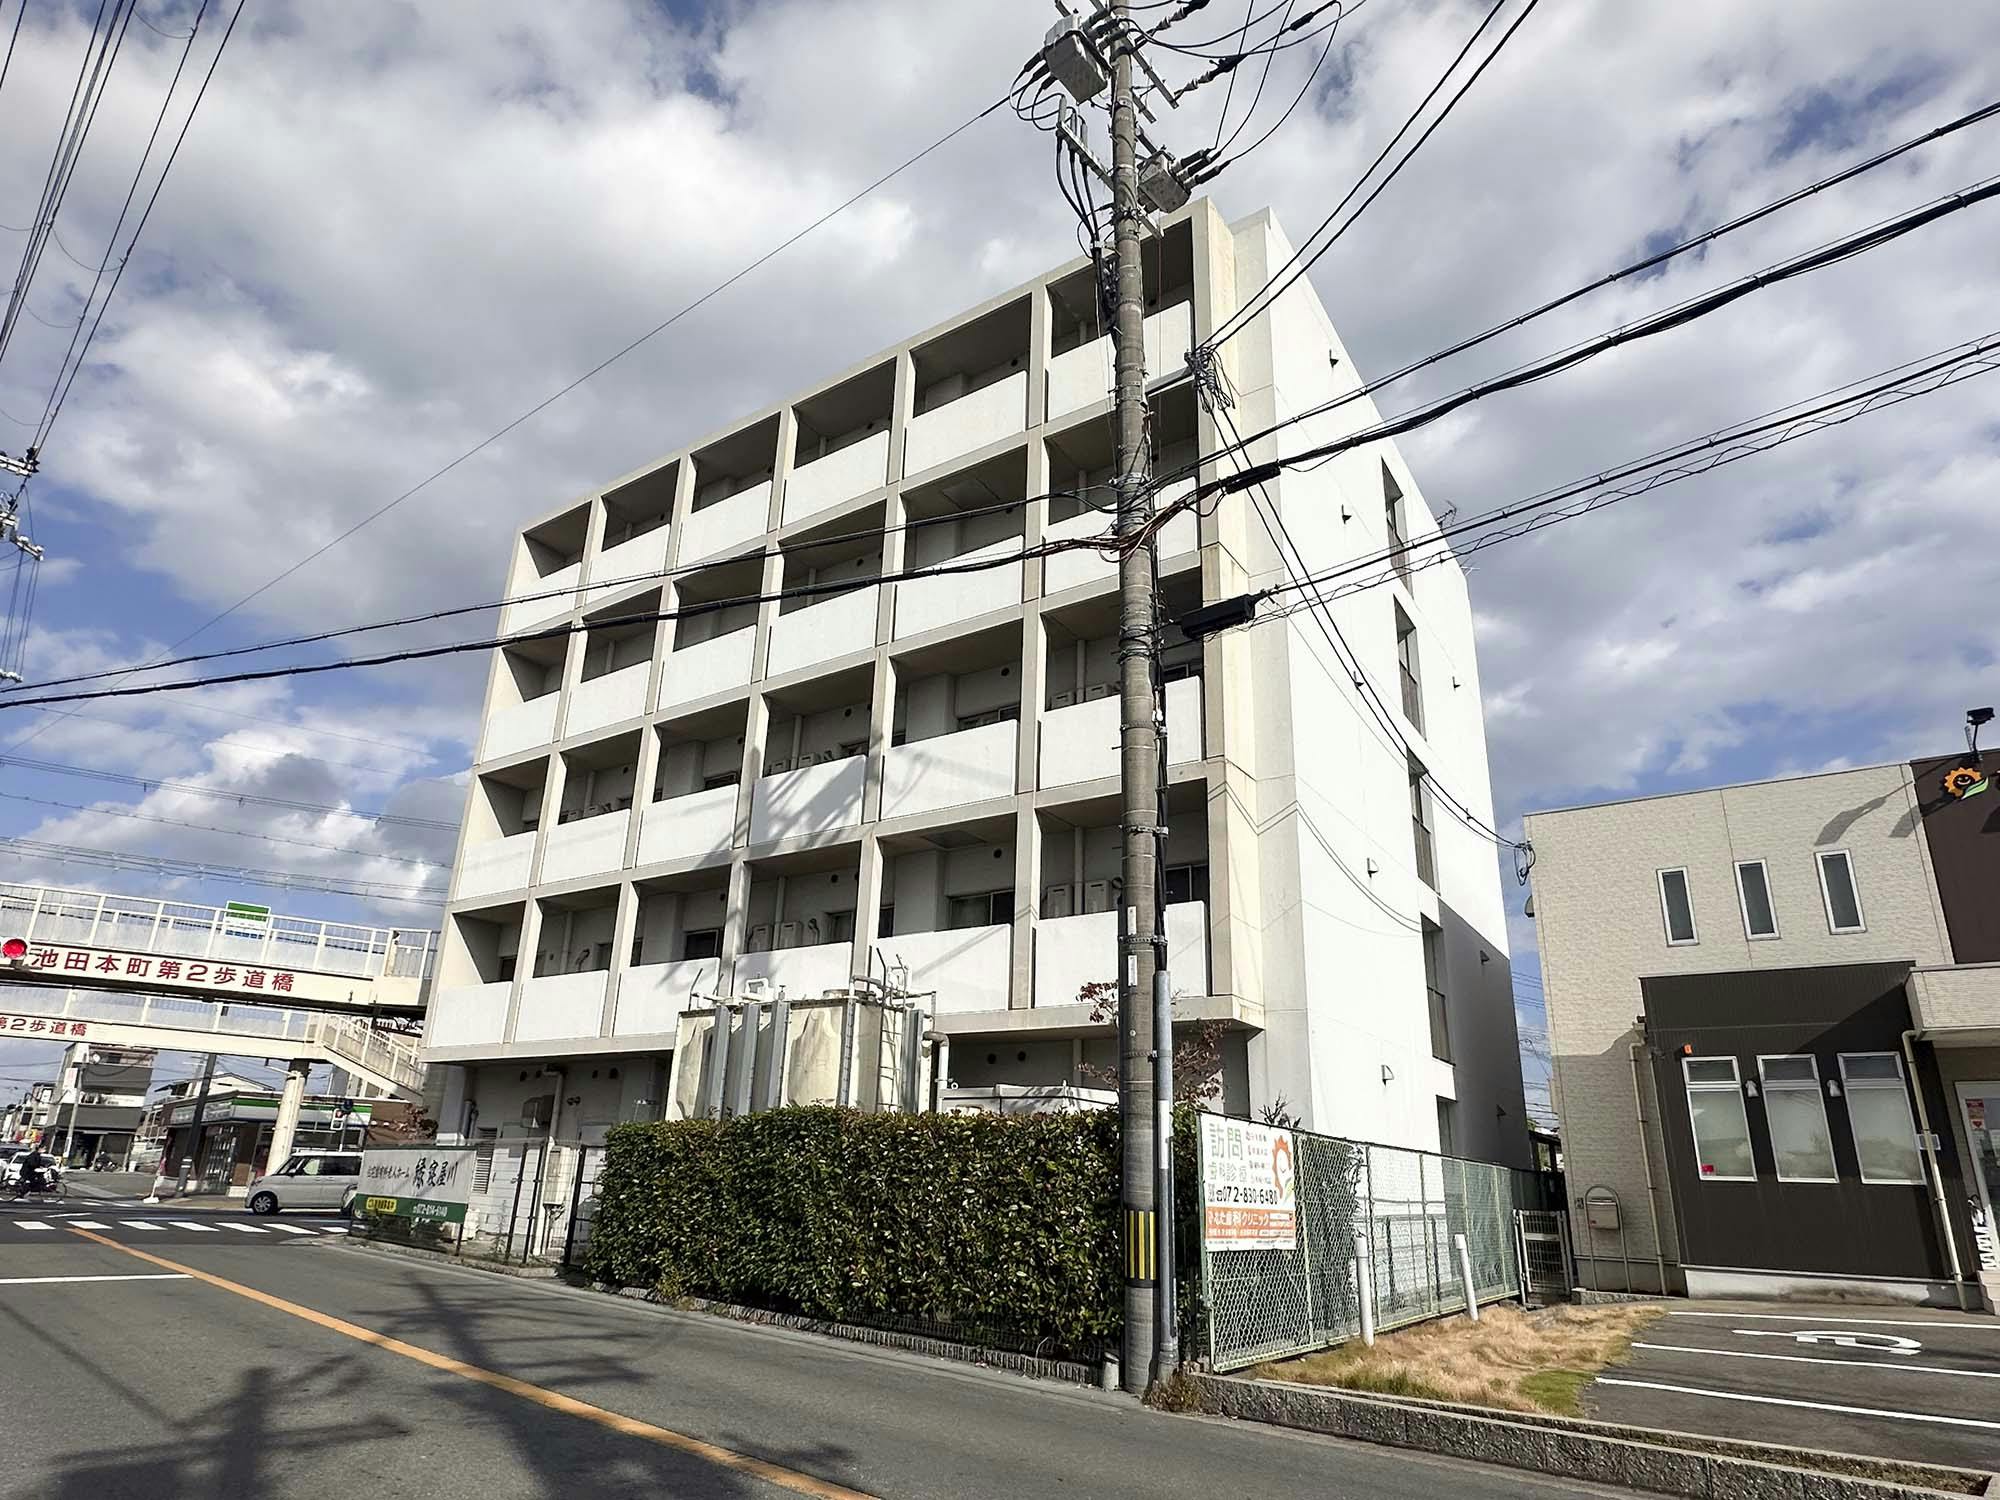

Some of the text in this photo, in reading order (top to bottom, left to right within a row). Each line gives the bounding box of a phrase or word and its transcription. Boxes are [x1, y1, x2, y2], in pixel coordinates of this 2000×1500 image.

[32, 948, 296, 992] 池田本町第2歩道橋
[1208, 1122, 1243, 1160] 訪問
